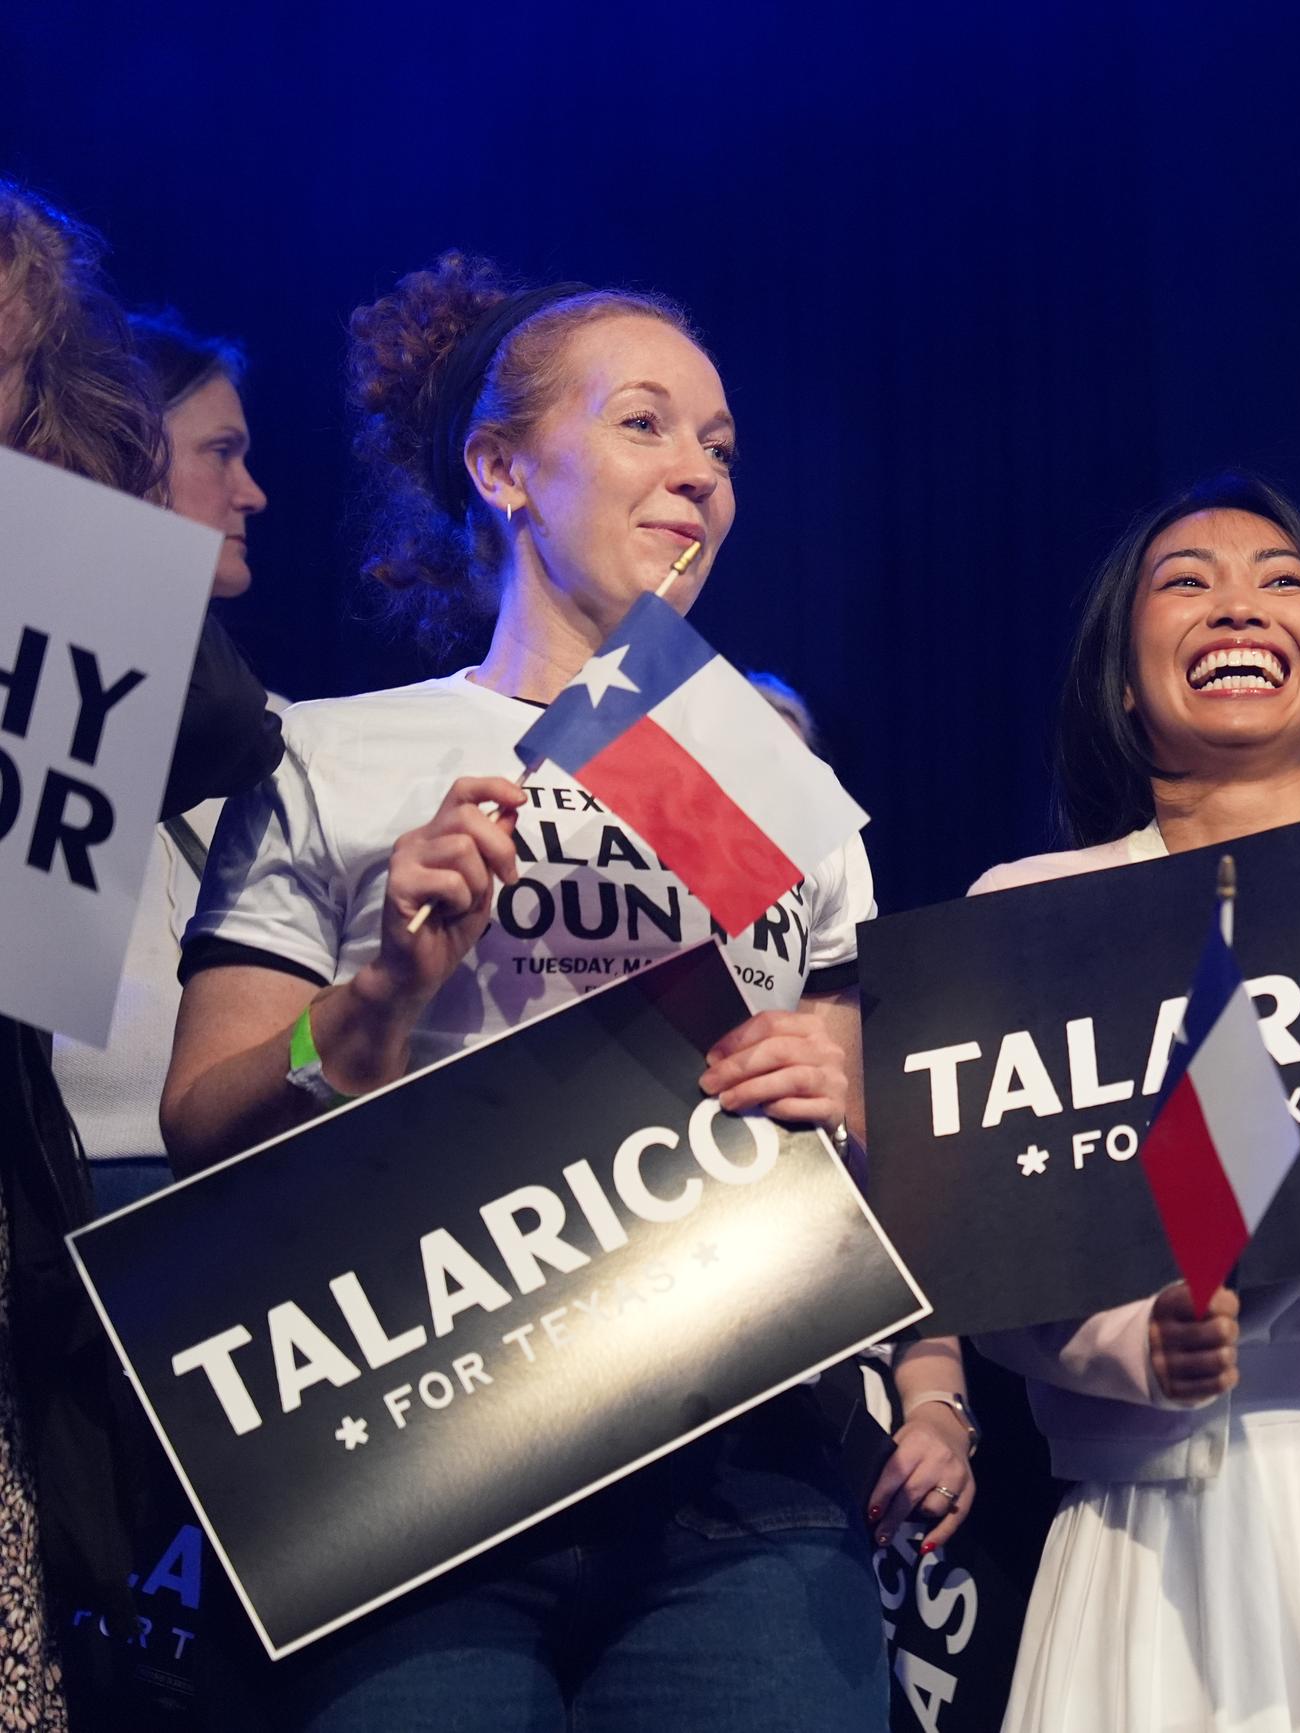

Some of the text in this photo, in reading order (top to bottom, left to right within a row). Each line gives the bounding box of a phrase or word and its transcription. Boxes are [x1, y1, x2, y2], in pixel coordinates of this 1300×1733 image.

[479, 877, 809, 978] OUNRY
[1072, 1120, 1150, 1170] FO
[171, 1098, 780, 1436] TALARICO
[383, 1260, 677, 1429] FOR TEXAS
